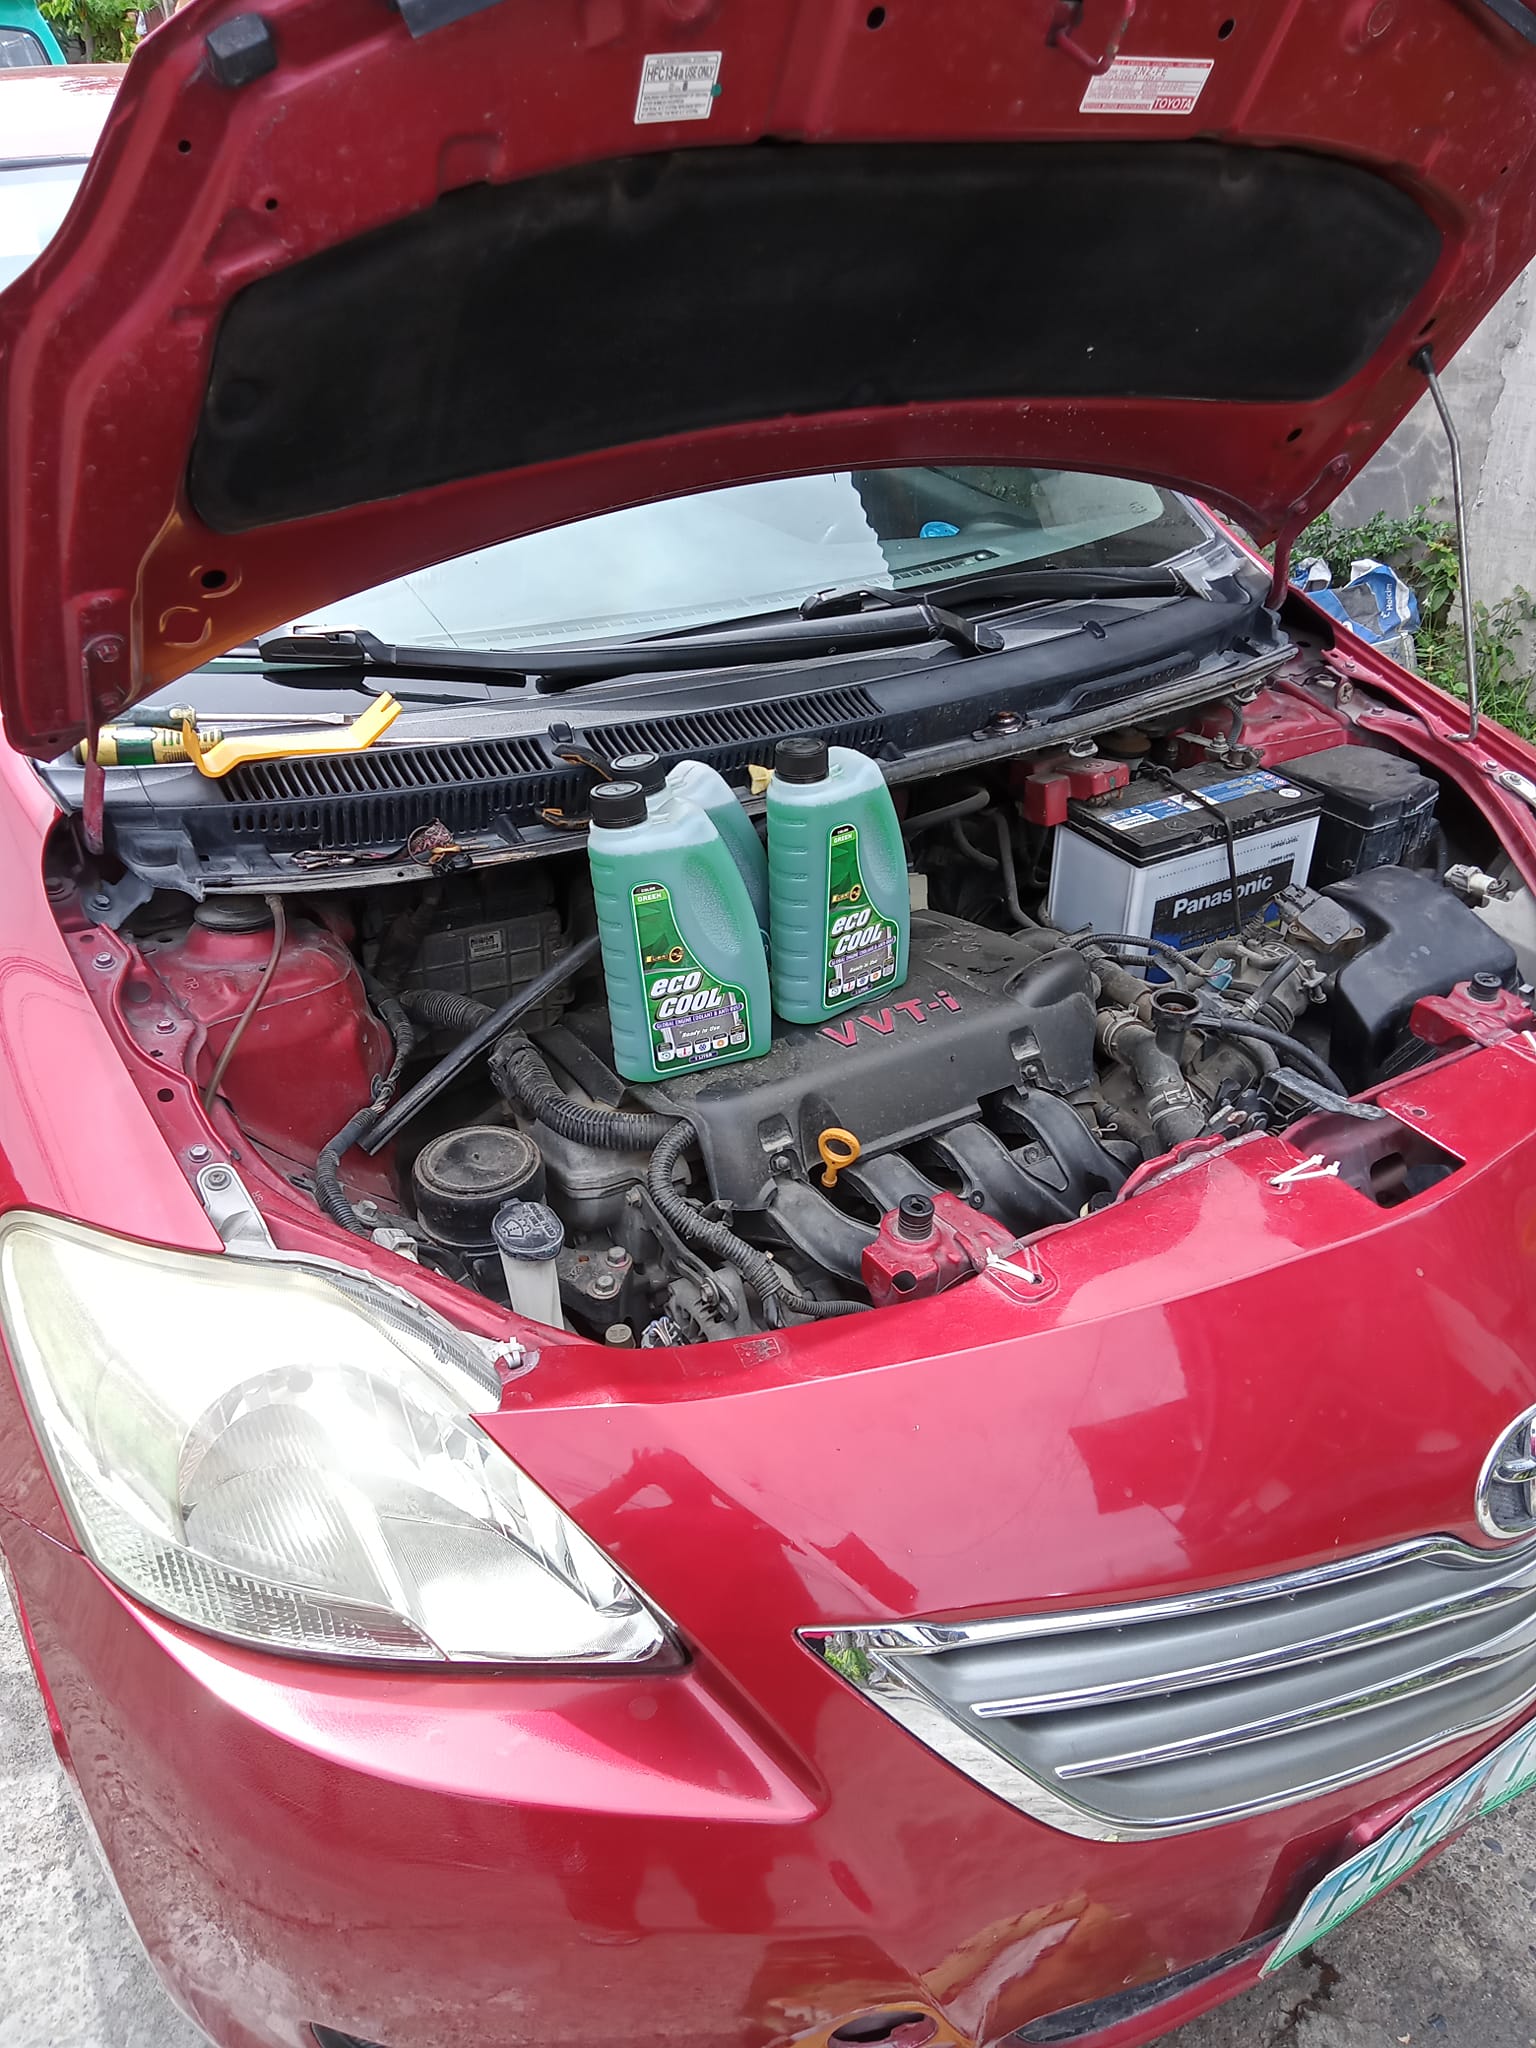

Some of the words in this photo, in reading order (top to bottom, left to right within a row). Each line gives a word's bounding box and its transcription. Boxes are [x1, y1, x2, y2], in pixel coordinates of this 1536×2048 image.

[1154, 97, 1192, 110] TOYOTA
[833, 833, 853, 844] GREEN
[637, 892, 662, 903] GREEN
[1172, 874, 1273, 919] Panasonic
[834, 922, 882, 956] COOL
[658, 987, 722, 1018] COOL
[657, 1020, 675, 1029] GLOBAL
[675, 1016, 691, 1026] ENGINE
[692, 1011, 713, 1021] COOLANT
[819, 990, 961, 1047] VVT-i
[682, 1029, 700, 1039] Ready
